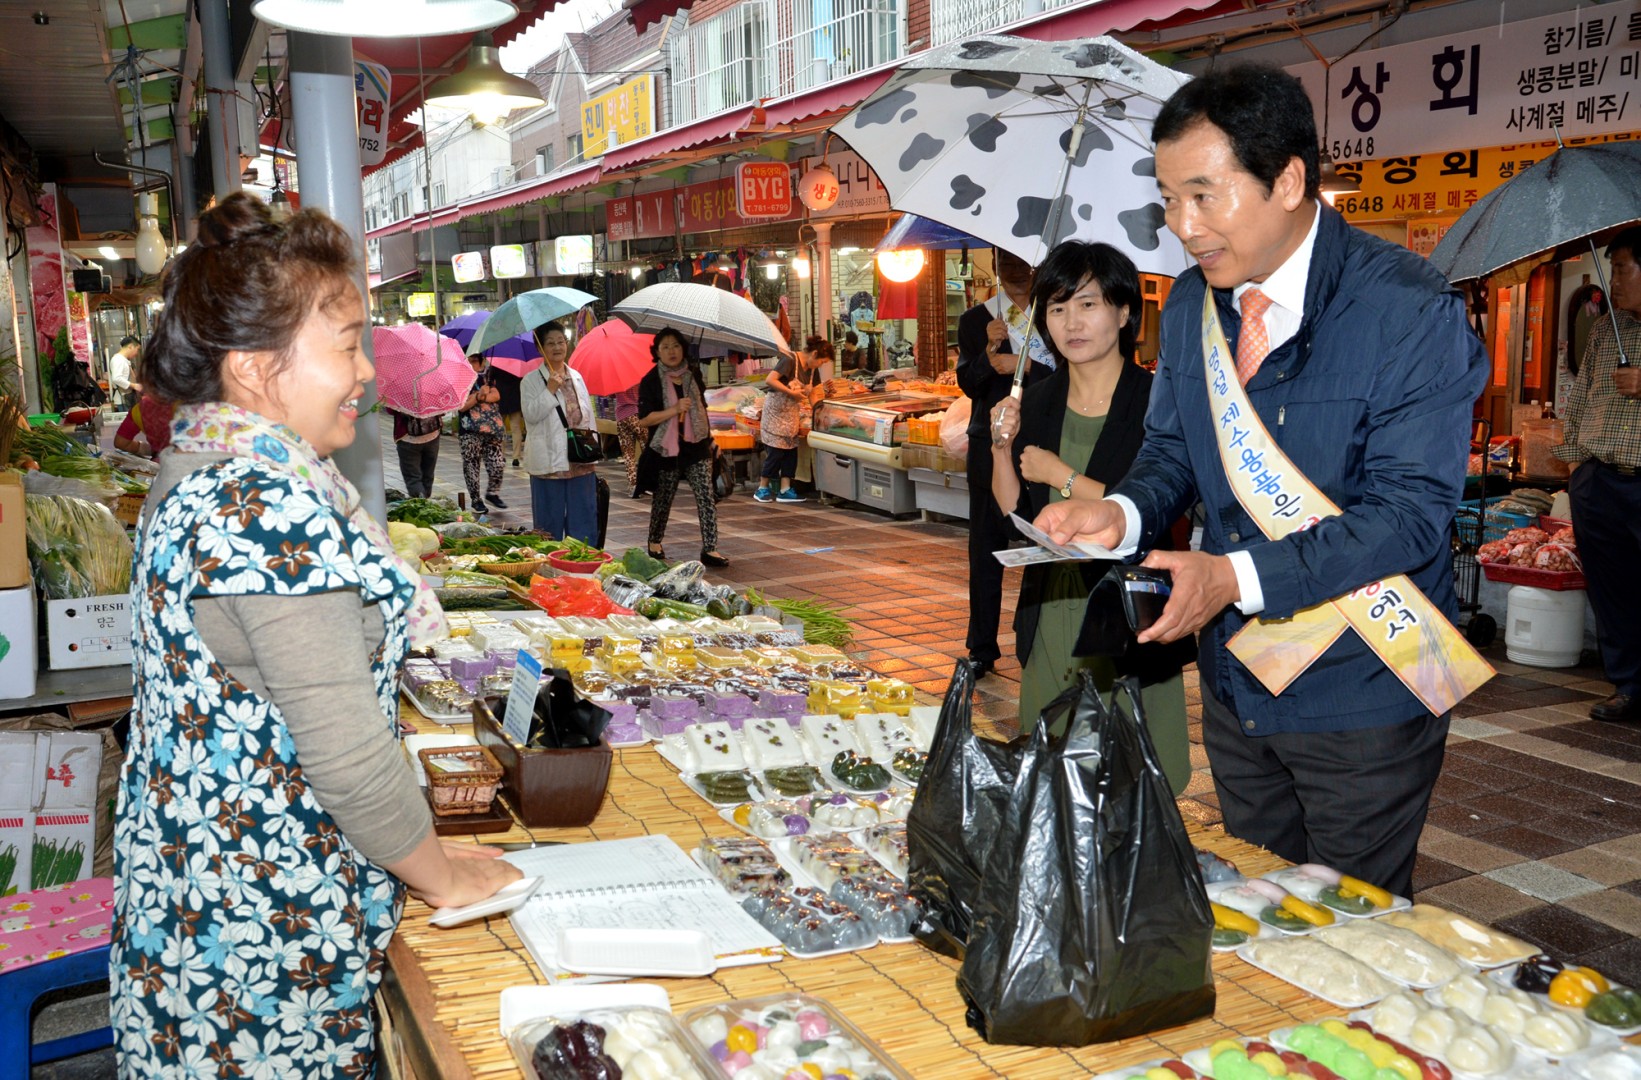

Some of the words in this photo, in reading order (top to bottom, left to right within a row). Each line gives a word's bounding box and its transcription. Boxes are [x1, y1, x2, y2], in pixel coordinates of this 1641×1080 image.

[1544, 16, 1617, 56] 참기름/
[1517, 56, 1609, 96] 생콩분말/
[1506, 100, 1566, 133] 사계절
[1576, 91, 1629, 124] 메주/
[1392, 192, 1437, 211] 사계절
[1447, 190, 1478, 209] 메주
[86, 602, 124, 613] FRESH
[97, 616, 115, 629] 당근
